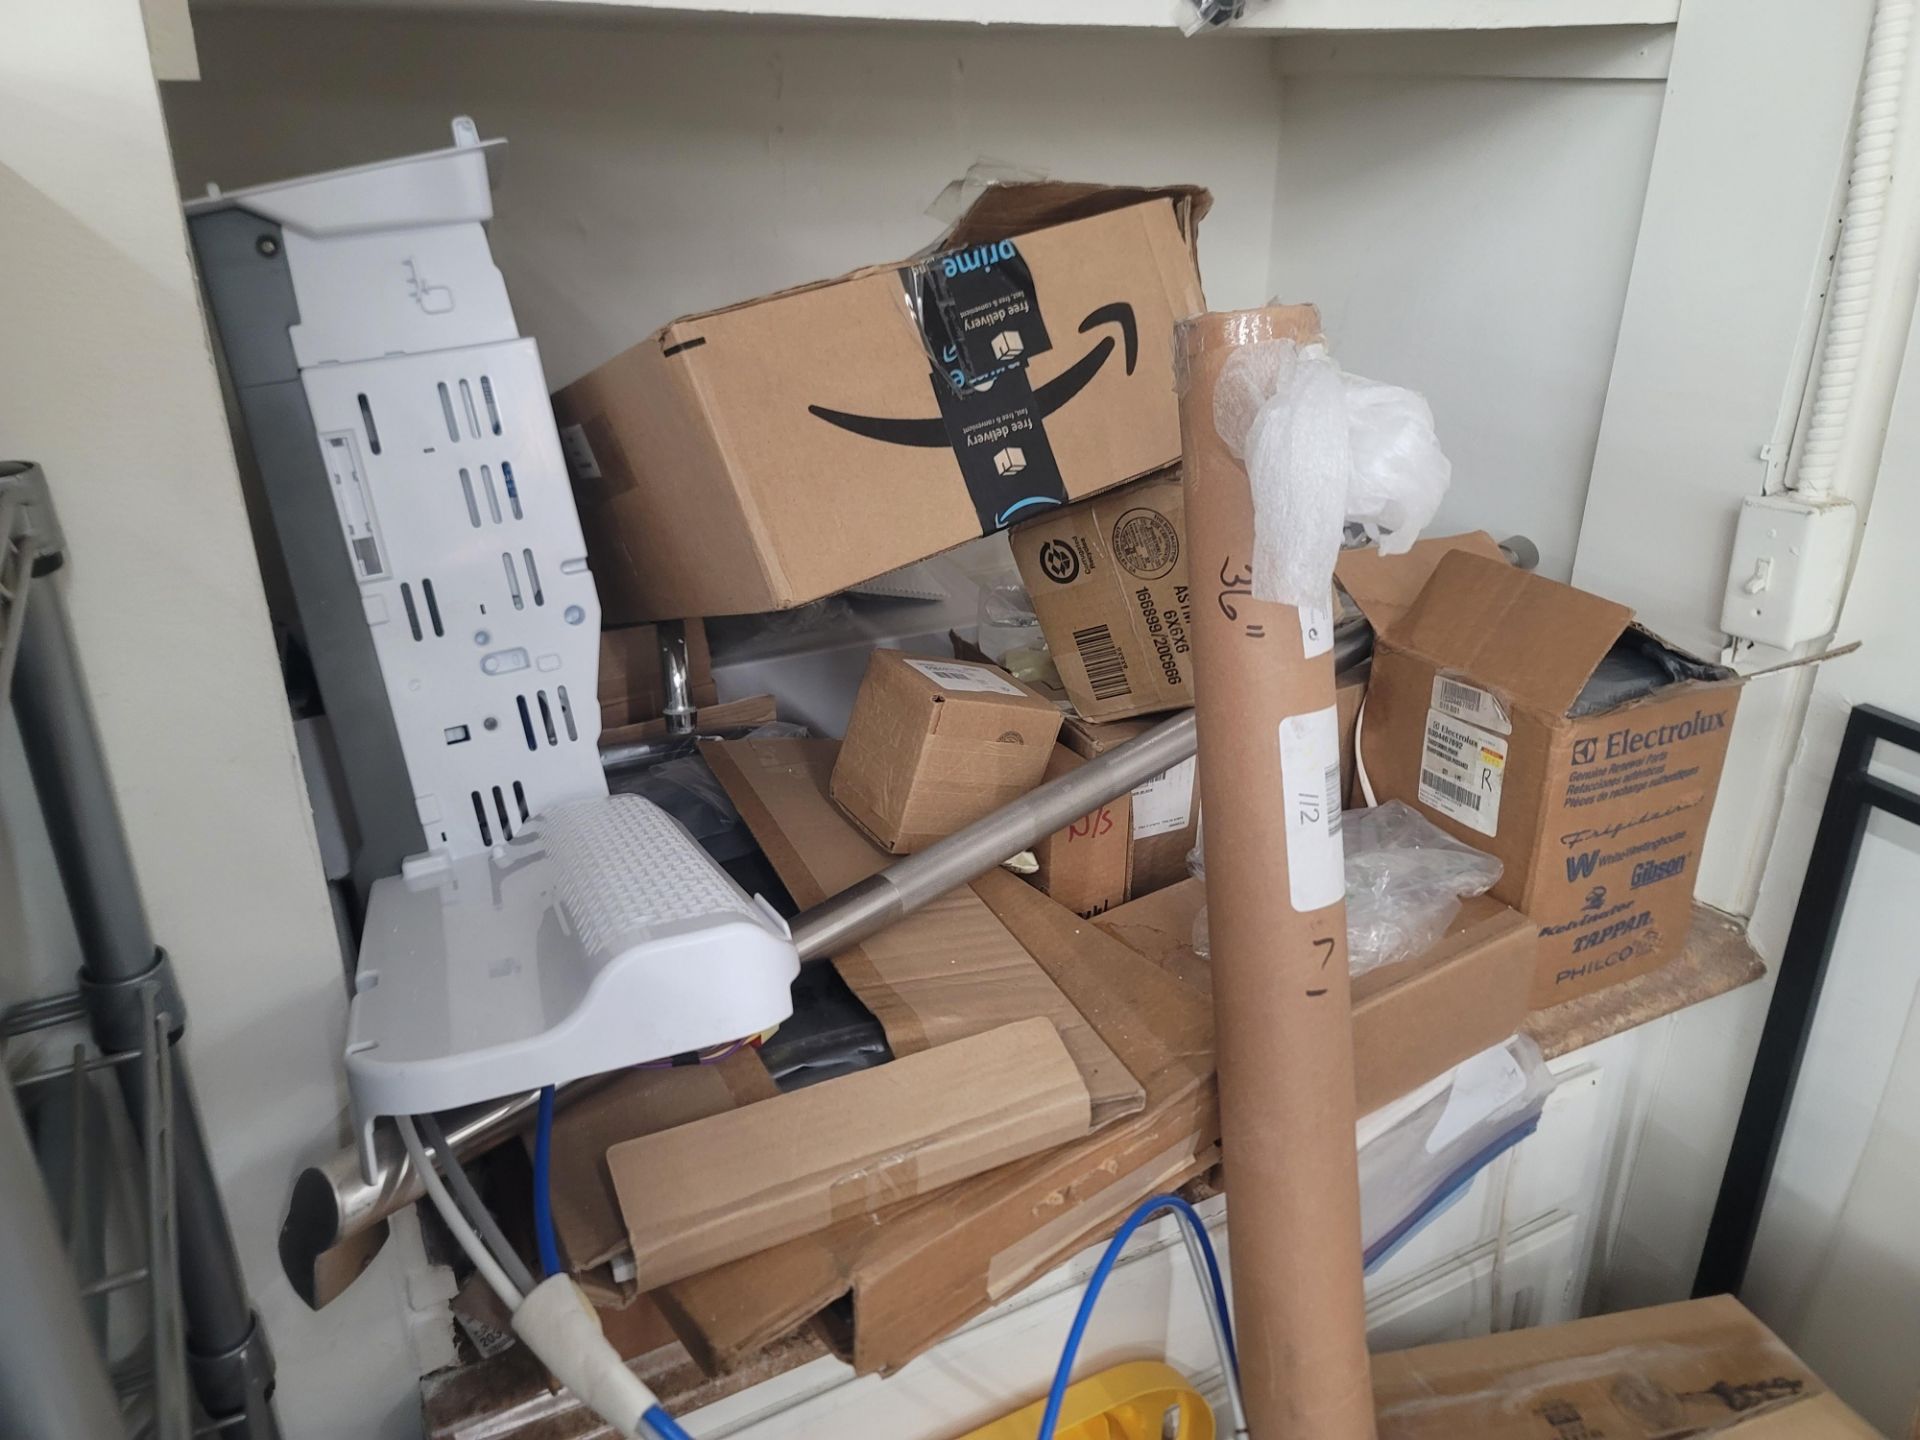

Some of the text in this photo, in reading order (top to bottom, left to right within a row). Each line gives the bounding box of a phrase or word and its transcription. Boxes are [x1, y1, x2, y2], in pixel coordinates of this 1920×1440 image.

[943, 239, 1016, 278] prime
[960, 302, 993, 319] convenient
[1000, 294, 1011, 303] free
[964, 300, 1029, 332] free delivery
[962, 419, 995, 435] convenient
[966, 417, 1033, 447] free delivery
[1002, 411, 1014, 422] free
[1072, 535, 1091, 575] Corrugated
[1135, 586, 1182, 686] 166899/20C666
[1163, 609, 1190, 654] 6X6X6
[1441, 723, 1478, 748] Electrolux
[1605, 709, 1728, 759] Electrolux
[1480, 767, 1493, 793] R
[1569, 764, 1608, 782] Genuine
[1645, 751, 1669, 765] Parts
[1566, 774, 1622, 795] Refacciones
[1597, 791, 1608, 802] de
[1630, 854, 1686, 888] Gibson
[1537, 900, 1635, 938] Kelvinator
[1556, 945, 1634, 984] PHILCO
